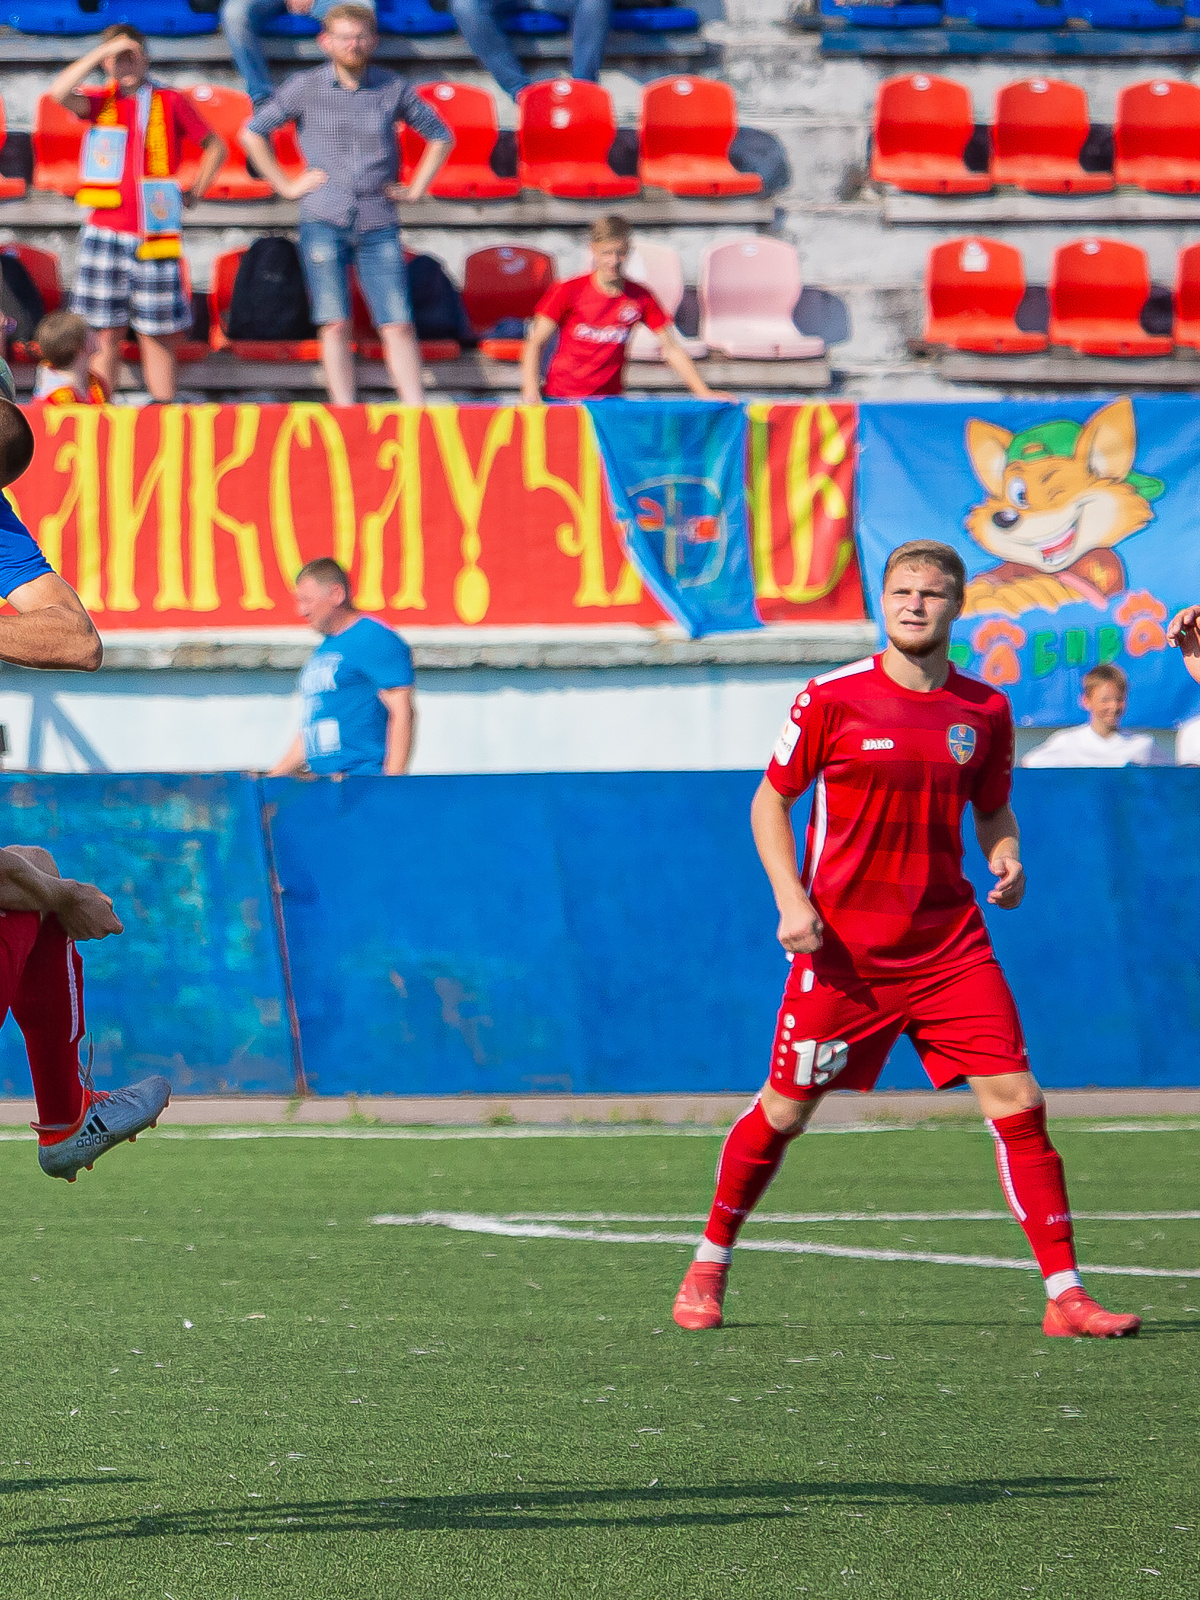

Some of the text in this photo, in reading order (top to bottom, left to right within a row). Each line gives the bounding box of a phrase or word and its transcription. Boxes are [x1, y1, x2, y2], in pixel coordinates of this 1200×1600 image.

[860, 737, 895, 751] JAKO
[791, 1038, 850, 1086] 19
[76, 1132, 117, 1149] adidas
